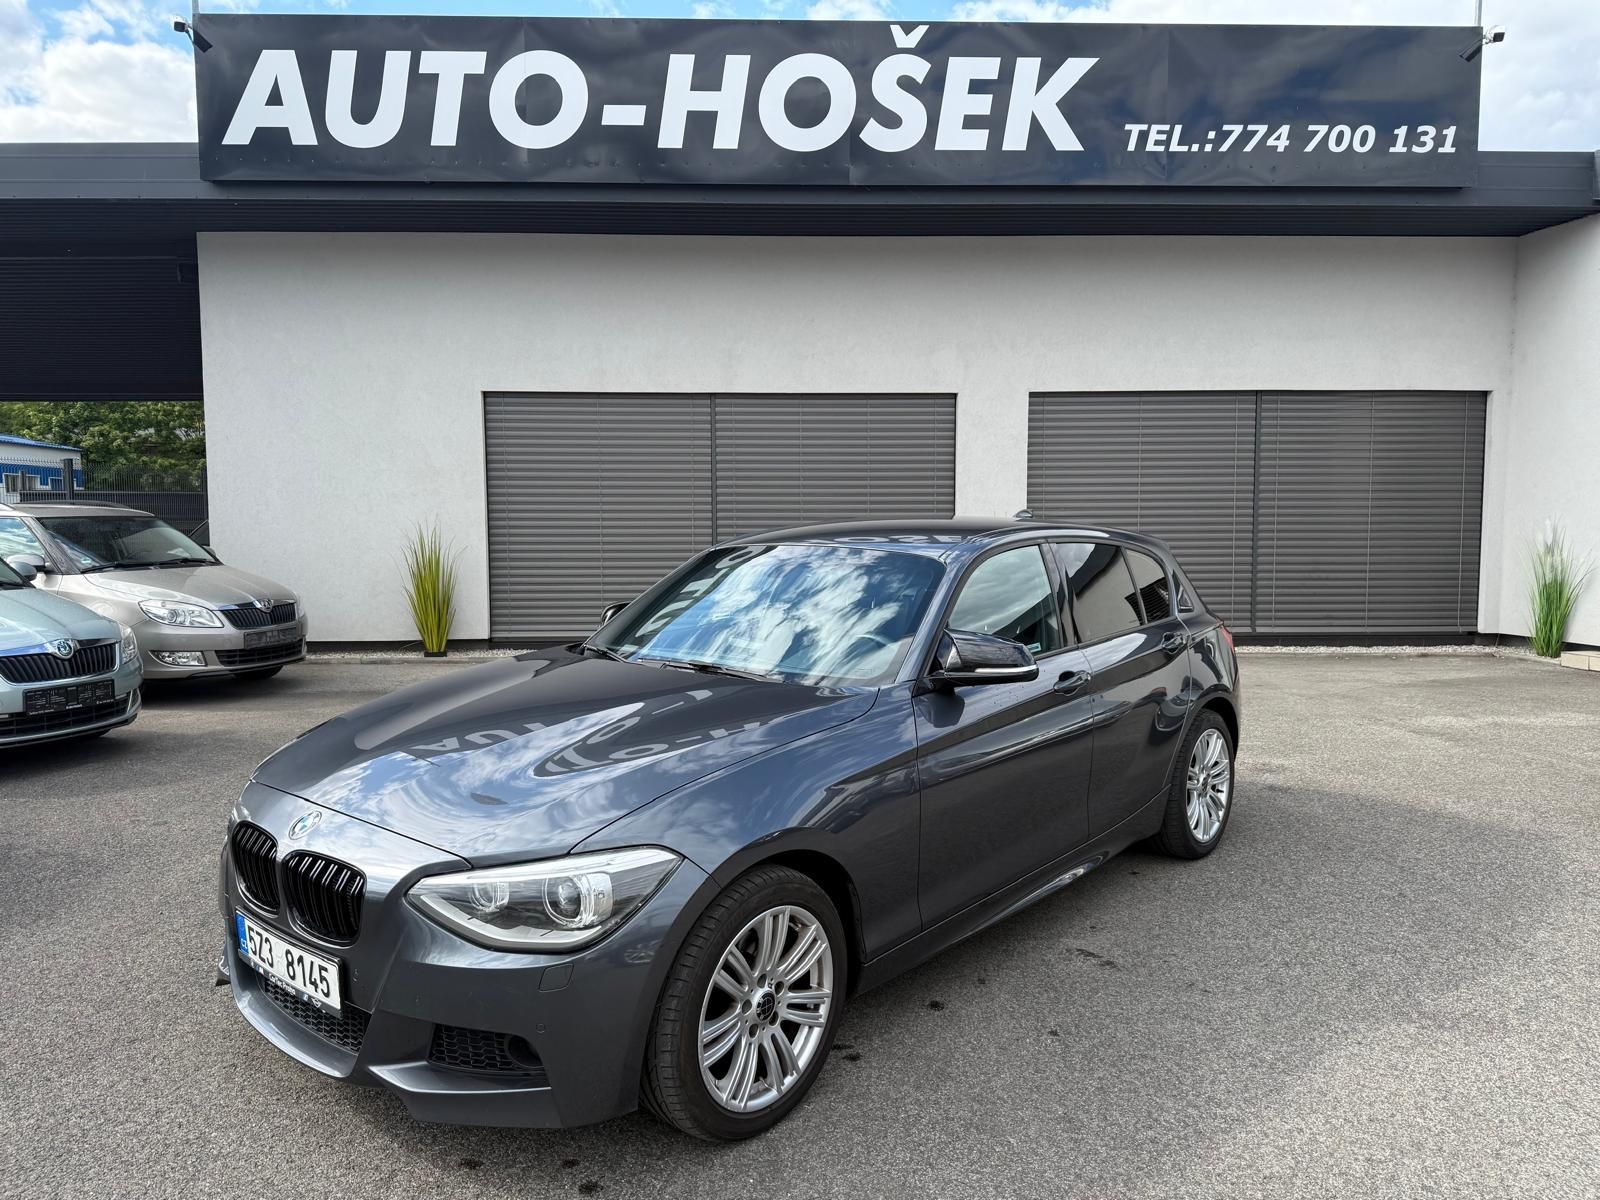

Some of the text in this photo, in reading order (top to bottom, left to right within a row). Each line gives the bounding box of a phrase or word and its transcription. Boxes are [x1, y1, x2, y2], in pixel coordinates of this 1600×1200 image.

[222, 25, 1100, 152] AUTO-HOŠEK
[1124, 124, 1457, 154] TEL.:774 700 131
[248, 926, 330, 998] 5Z3 8145
